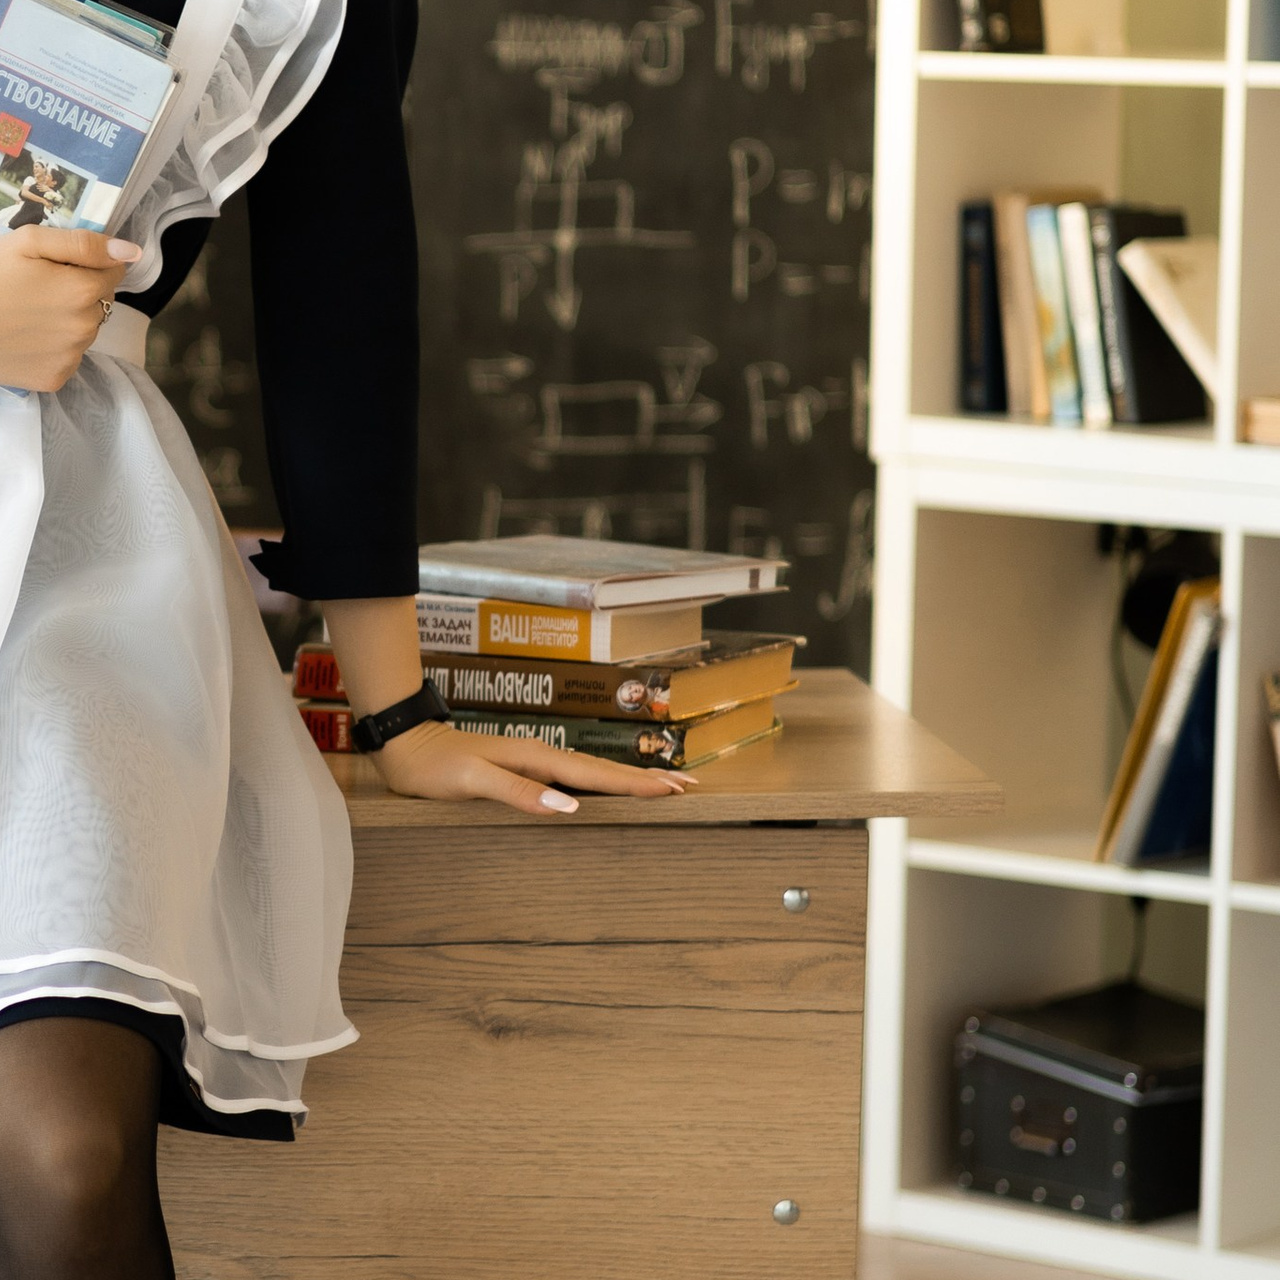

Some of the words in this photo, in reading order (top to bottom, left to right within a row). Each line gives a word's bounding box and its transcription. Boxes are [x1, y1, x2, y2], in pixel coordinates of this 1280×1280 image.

[53, 77, 95, 103] школьный
[93, 96, 127, 119] учебник
[431, 617, 472, 632] ЗАДАЧ
[489, 613, 530, 644] ВАШ
[531, 615, 579, 632] ДОМАШНИЙ
[531, 631, 579, 648] РЕПЕТИТОР
[452, 667, 554, 706] СПРАВОЧНИК
